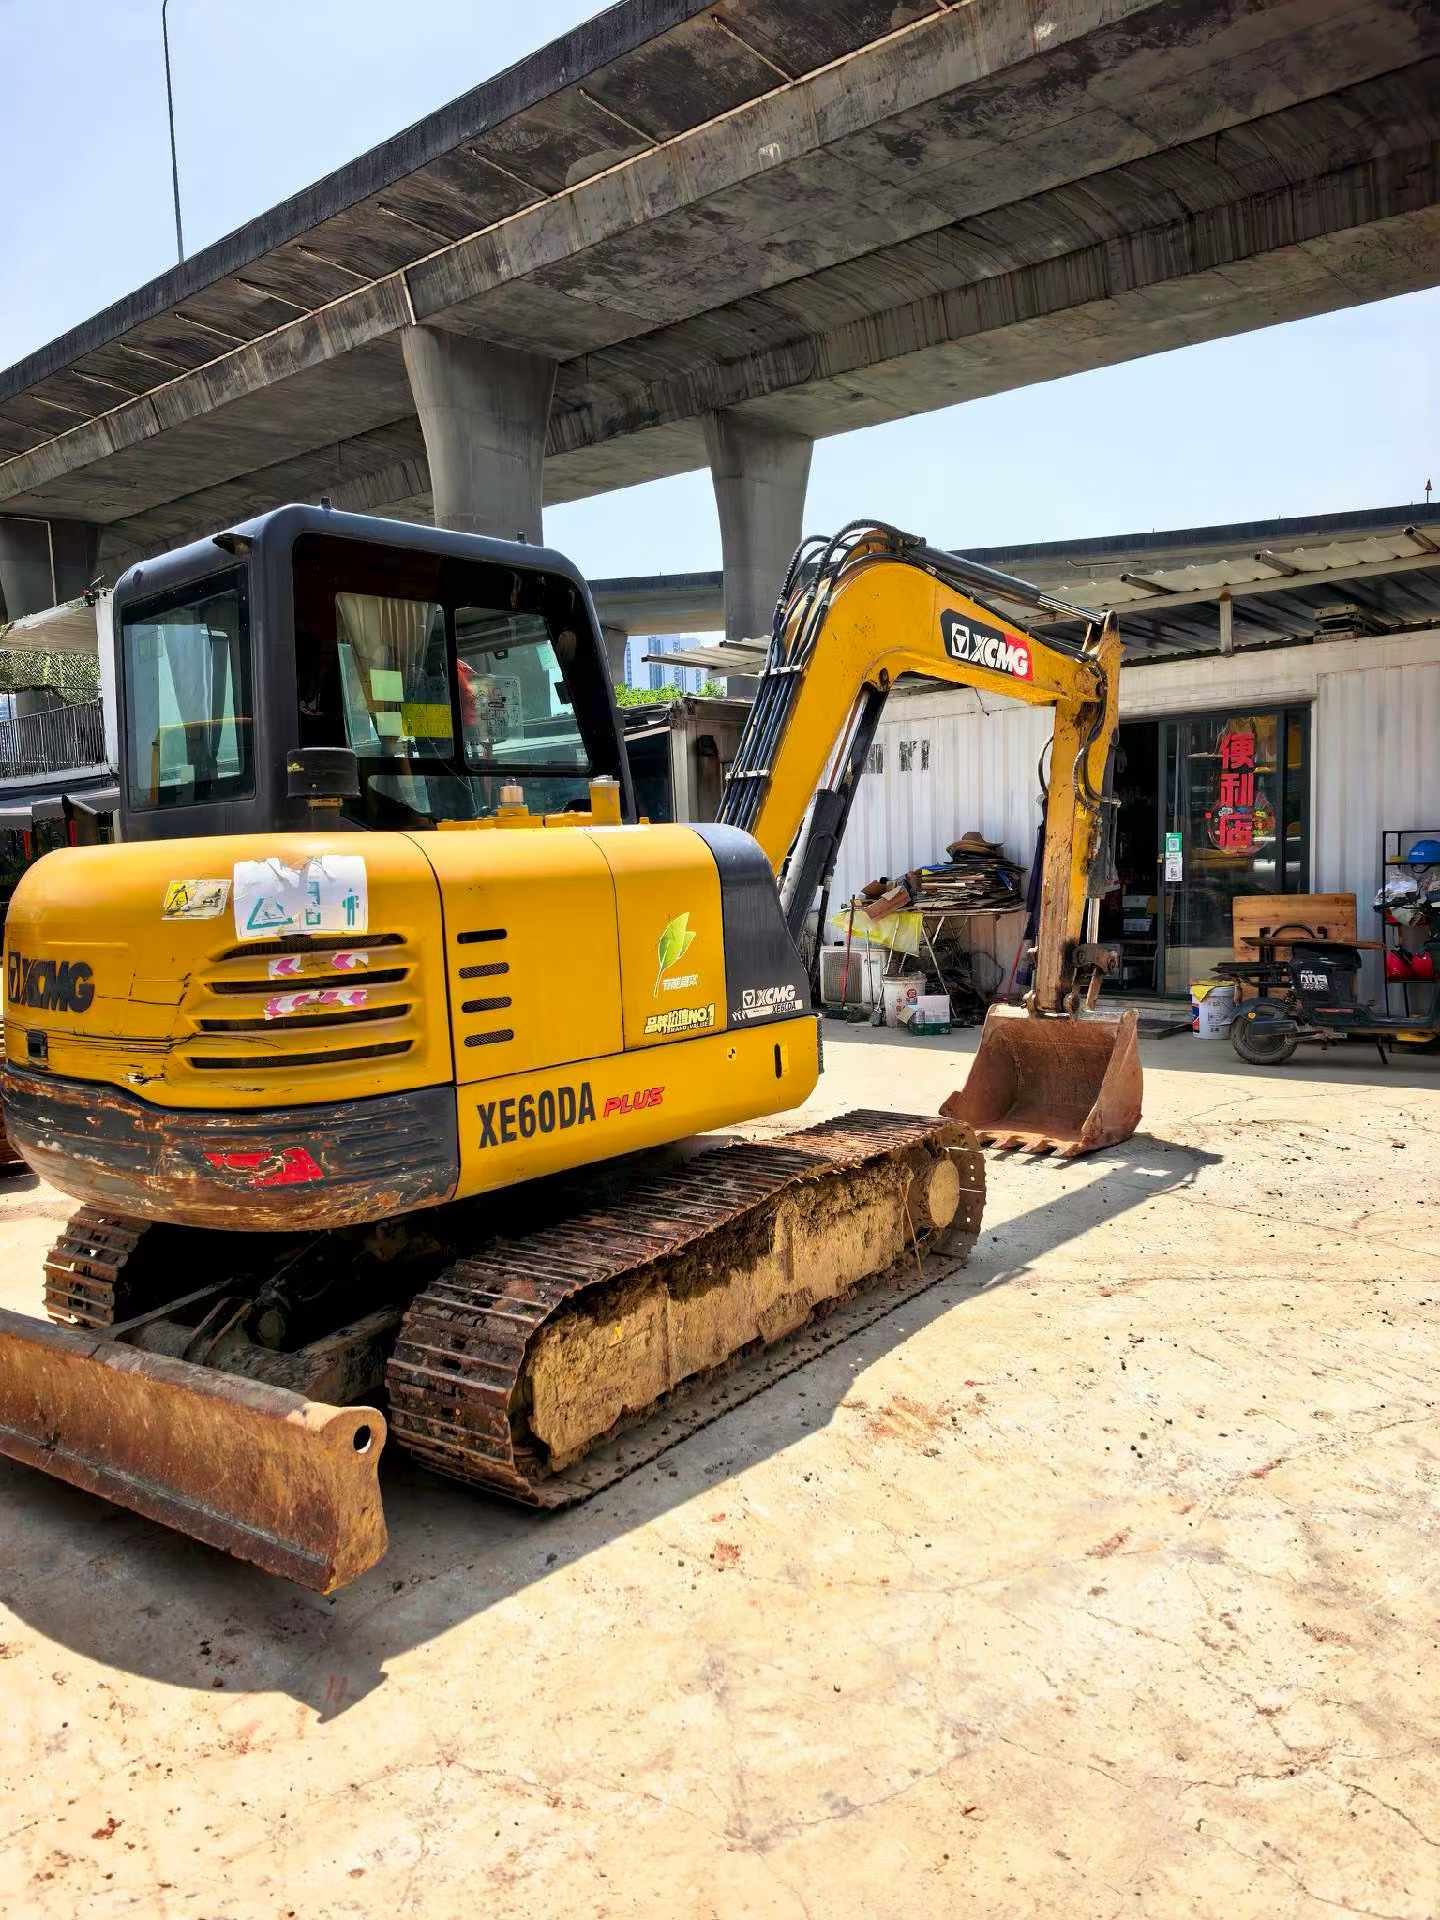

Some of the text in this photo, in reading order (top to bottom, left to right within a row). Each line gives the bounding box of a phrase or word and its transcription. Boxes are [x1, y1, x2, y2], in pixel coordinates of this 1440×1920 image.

[968, 633, 1028, 676] XCMG
[21, 958, 96, 1013] XCMG
[756, 984, 796, 1007] XCMG
[476, 1081, 665, 1149] XE60DA PLUS
